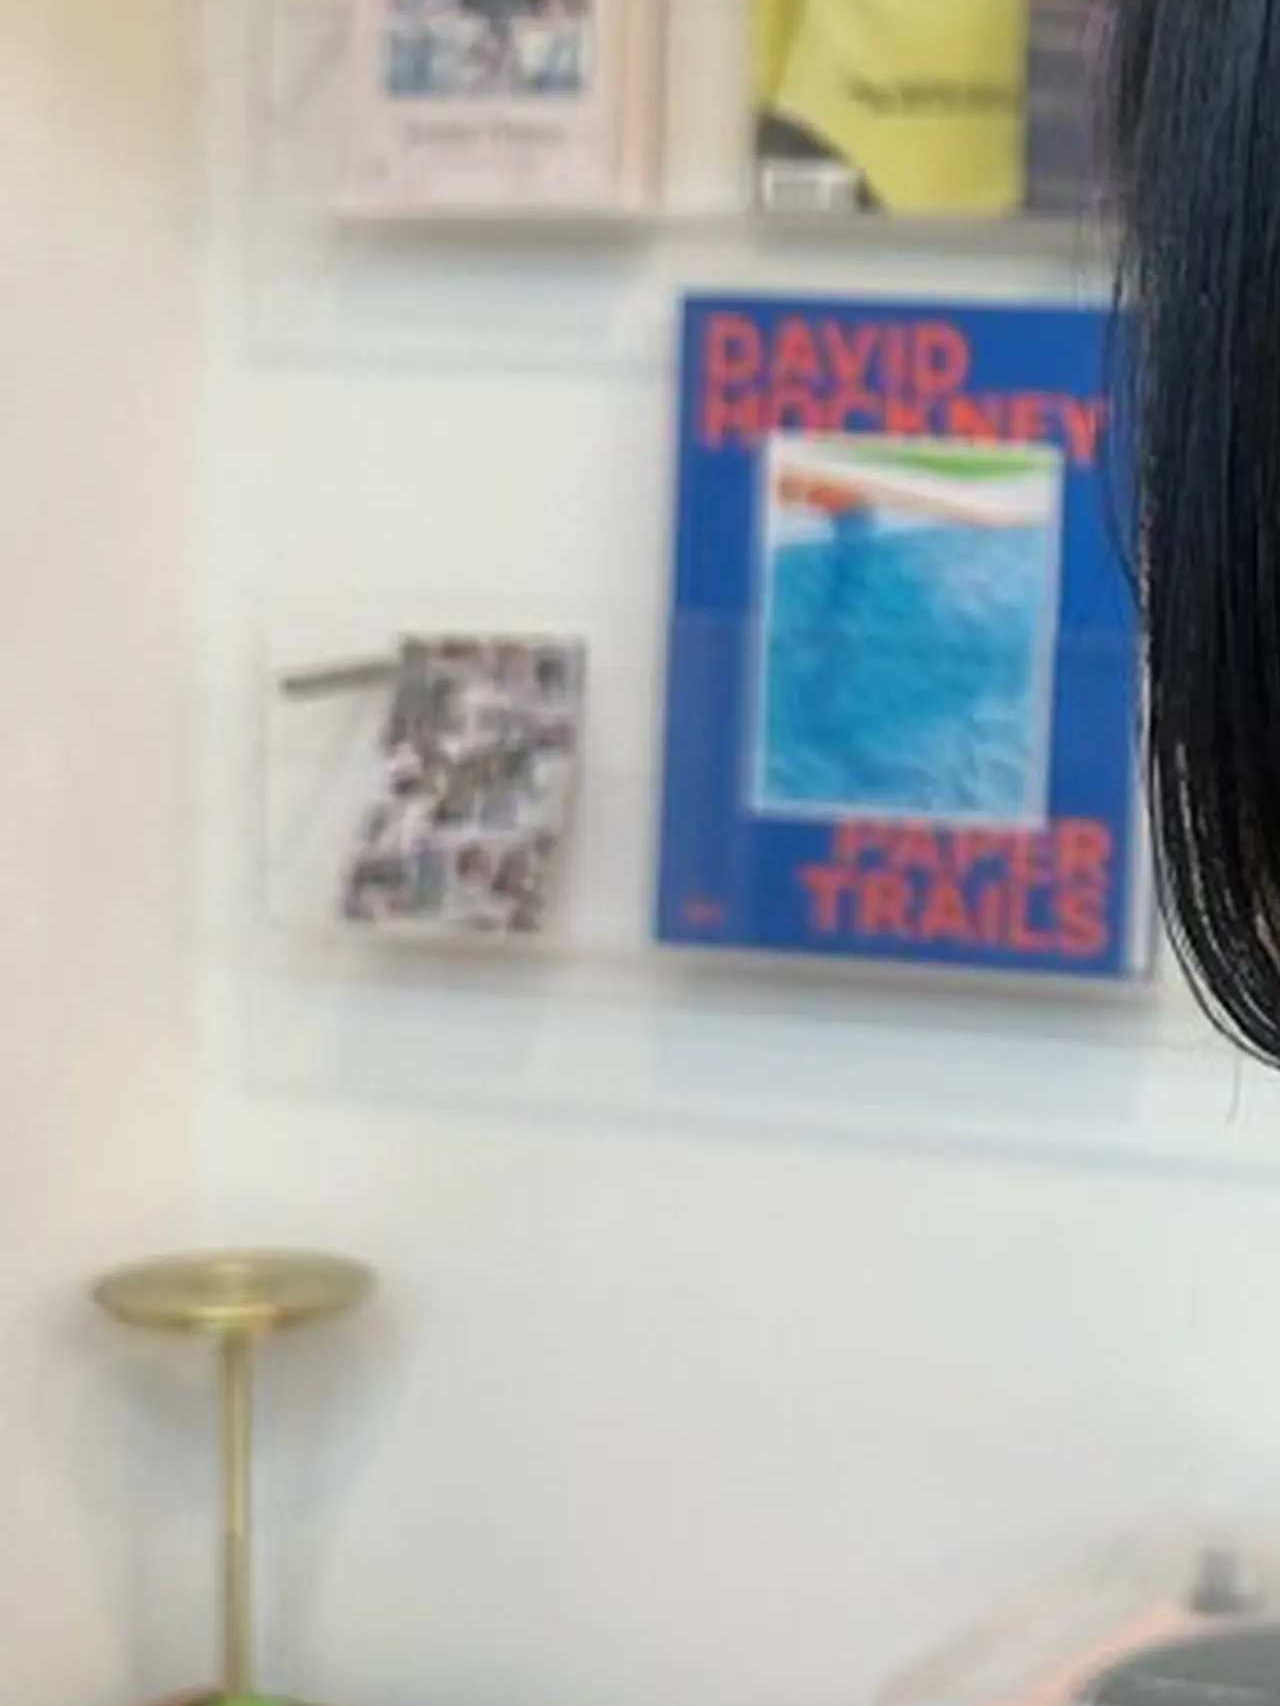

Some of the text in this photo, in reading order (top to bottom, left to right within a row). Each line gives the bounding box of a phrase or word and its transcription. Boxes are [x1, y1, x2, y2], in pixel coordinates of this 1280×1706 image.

[703, 311, 970, 393] DAVID
[703, 381, 1109, 463] HOCKNEY
[830, 817, 1110, 883] PAPER
[797, 863, 1108, 957] TRAILS
